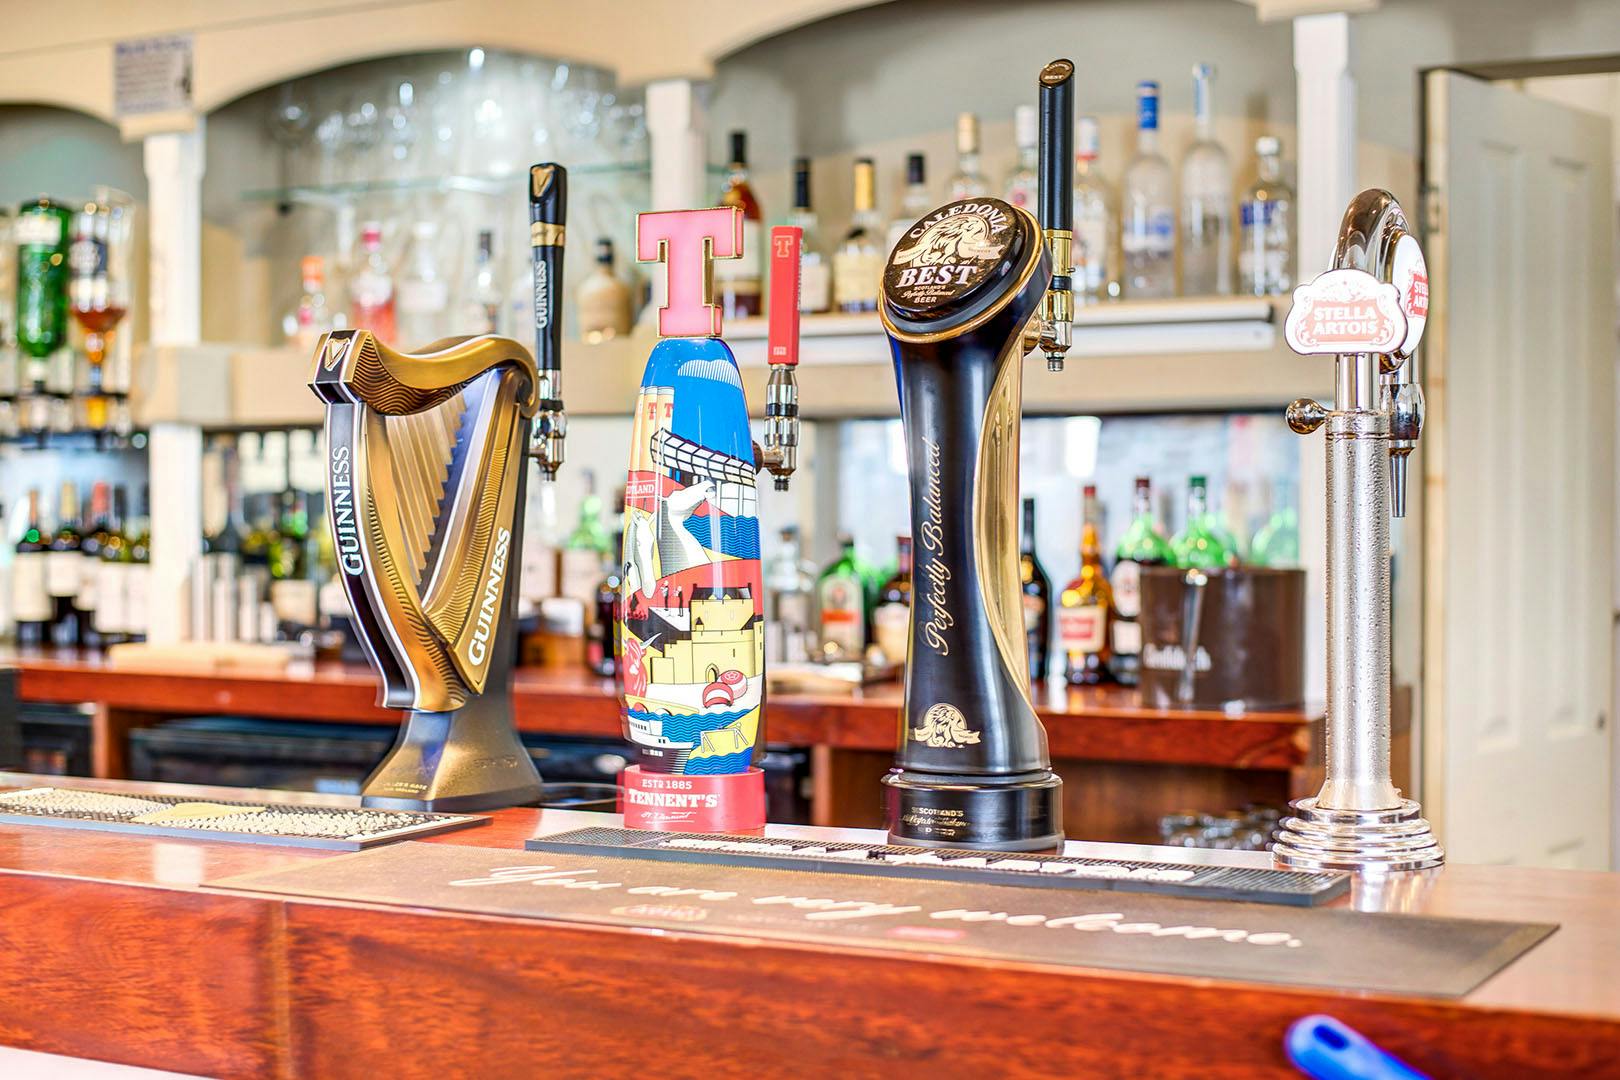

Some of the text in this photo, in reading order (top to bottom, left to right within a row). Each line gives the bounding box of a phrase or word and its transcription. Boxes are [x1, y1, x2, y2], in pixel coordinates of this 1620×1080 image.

[909, 203, 1008, 239] CALEDONIA
[774, 235, 794, 258] T
[635, 205, 745, 339] T
[895, 265, 978, 288] BEST
[535, 260, 548, 329] GUINNESS
[913, 296, 937, 304] BEER
[1313, 306, 1378, 321] STELLA
[1312, 321, 1378, 336] ARTOIS
[333, 446, 364, 577] GUINNESS
[920, 436, 954, 657] Perfectly Balanced
[468, 527, 511, 667] GUINNESS
[665, 780, 693, 790] 1885
[628, 788, 718, 808] TENNENT'S
[918, 808, 964, 817] SCOTAND'S
[449, 865, 622, 890] You
[627, 885, 738, 901] are
[752, 895, 922, 921] very
